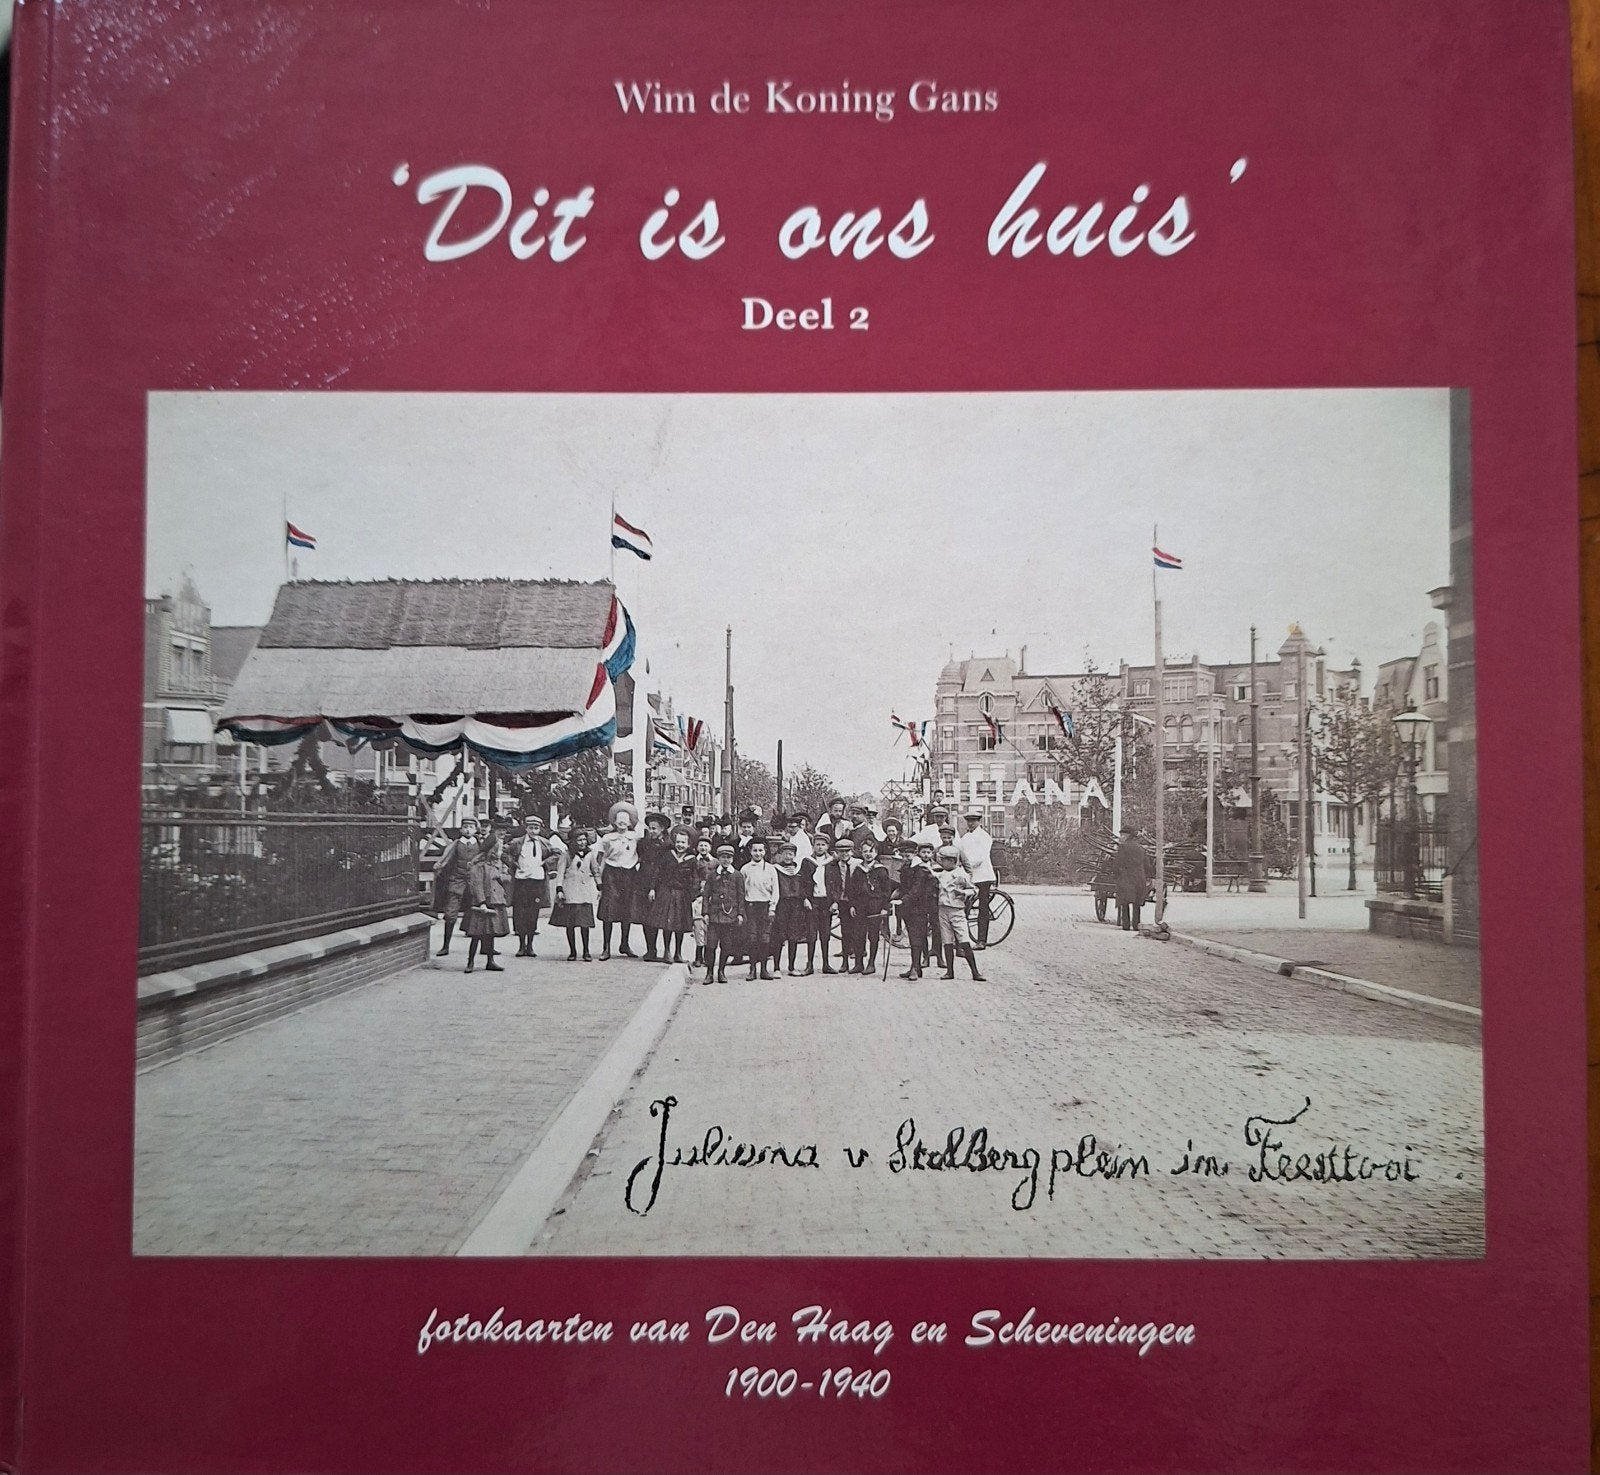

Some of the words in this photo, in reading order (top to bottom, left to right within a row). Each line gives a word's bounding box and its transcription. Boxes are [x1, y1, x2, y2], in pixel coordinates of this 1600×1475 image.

[612, 80, 696, 115] Wim
[709, 80, 750, 115] de
[765, 80, 897, 123] Koning
[907, 80, 999, 114] Gans
[638, 186, 727, 262] is
[777, 197, 937, 261] ons
[741, 296, 835, 332] Deel
[849, 306, 870, 332] 2
[624, 1095, 820, 1216] Juliana
[416, 1305, 615, 1355] fotokaarten
[628, 1318, 691, 1344] van
[704, 1305, 778, 1344] Den
[790, 1305, 896, 1356] Haag
[909, 1320, 949, 1344] en
[963, 1307, 1197, 1358] Scheveningen
[724, 1366, 893, 1399] 1900-1940
